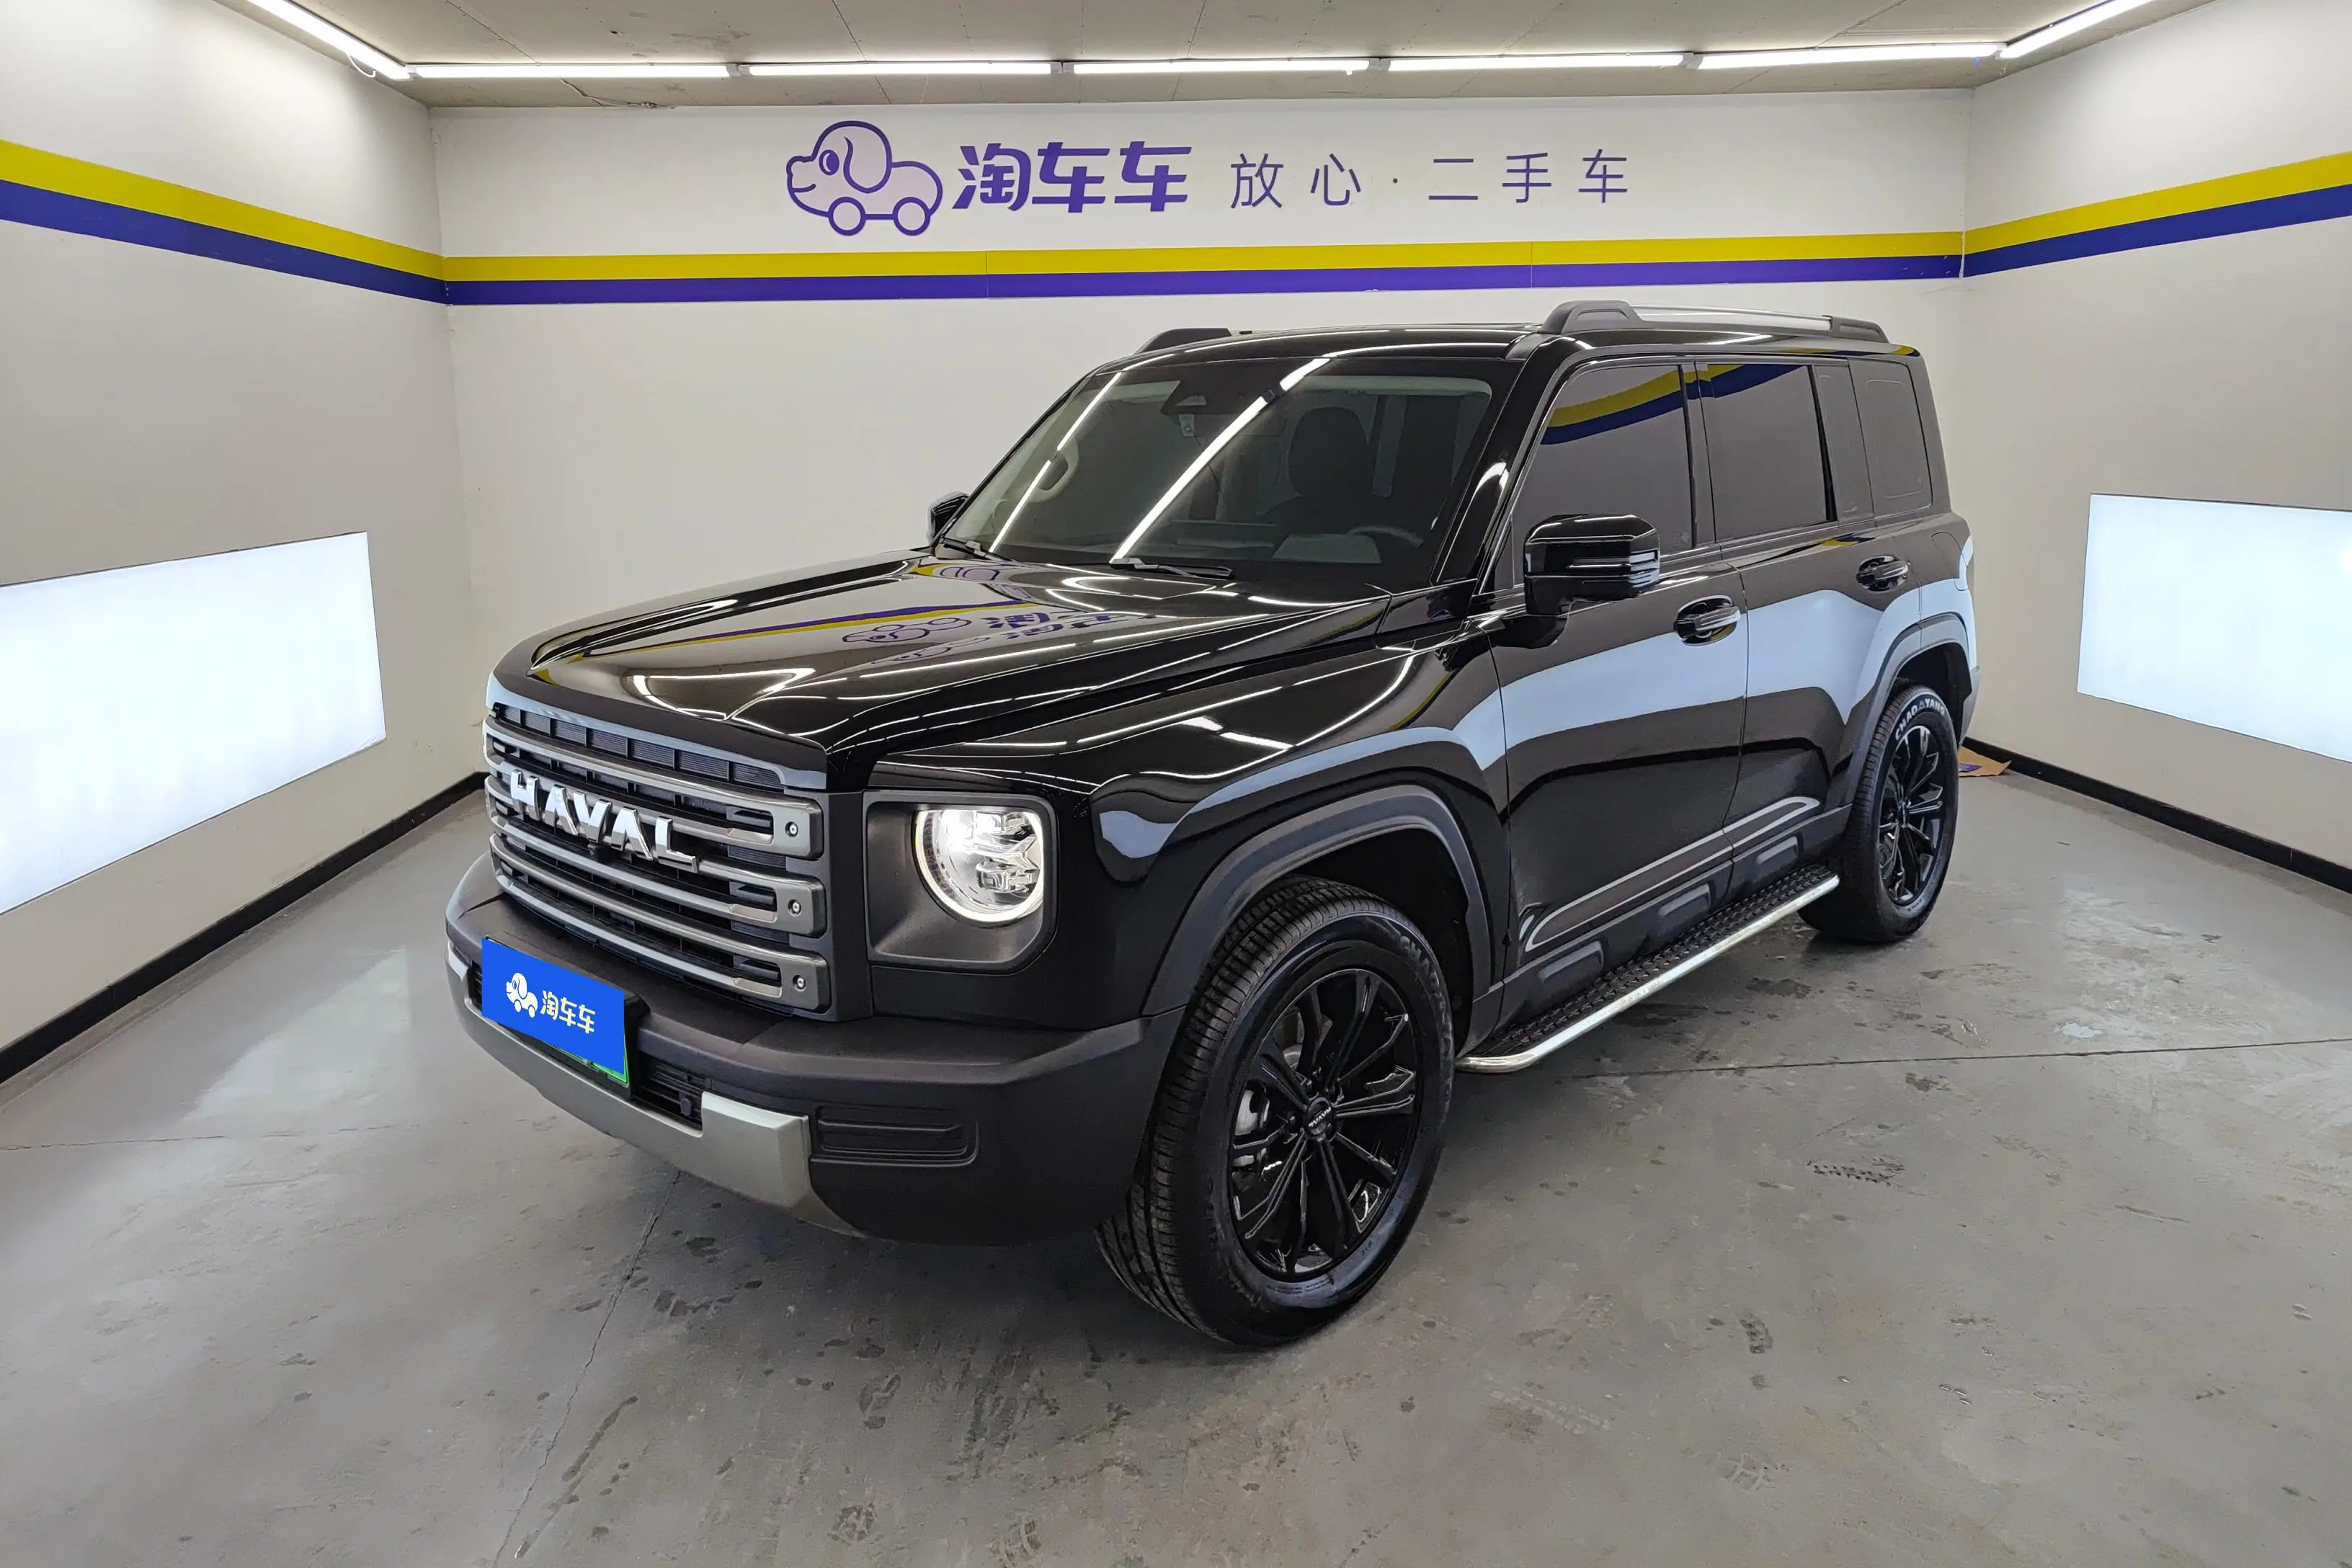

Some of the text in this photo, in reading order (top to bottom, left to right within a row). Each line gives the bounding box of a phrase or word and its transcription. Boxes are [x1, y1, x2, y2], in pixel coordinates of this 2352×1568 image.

[953, 141, 1192, 213] 淘车车
[509, 770, 699, 873] HAVAL
